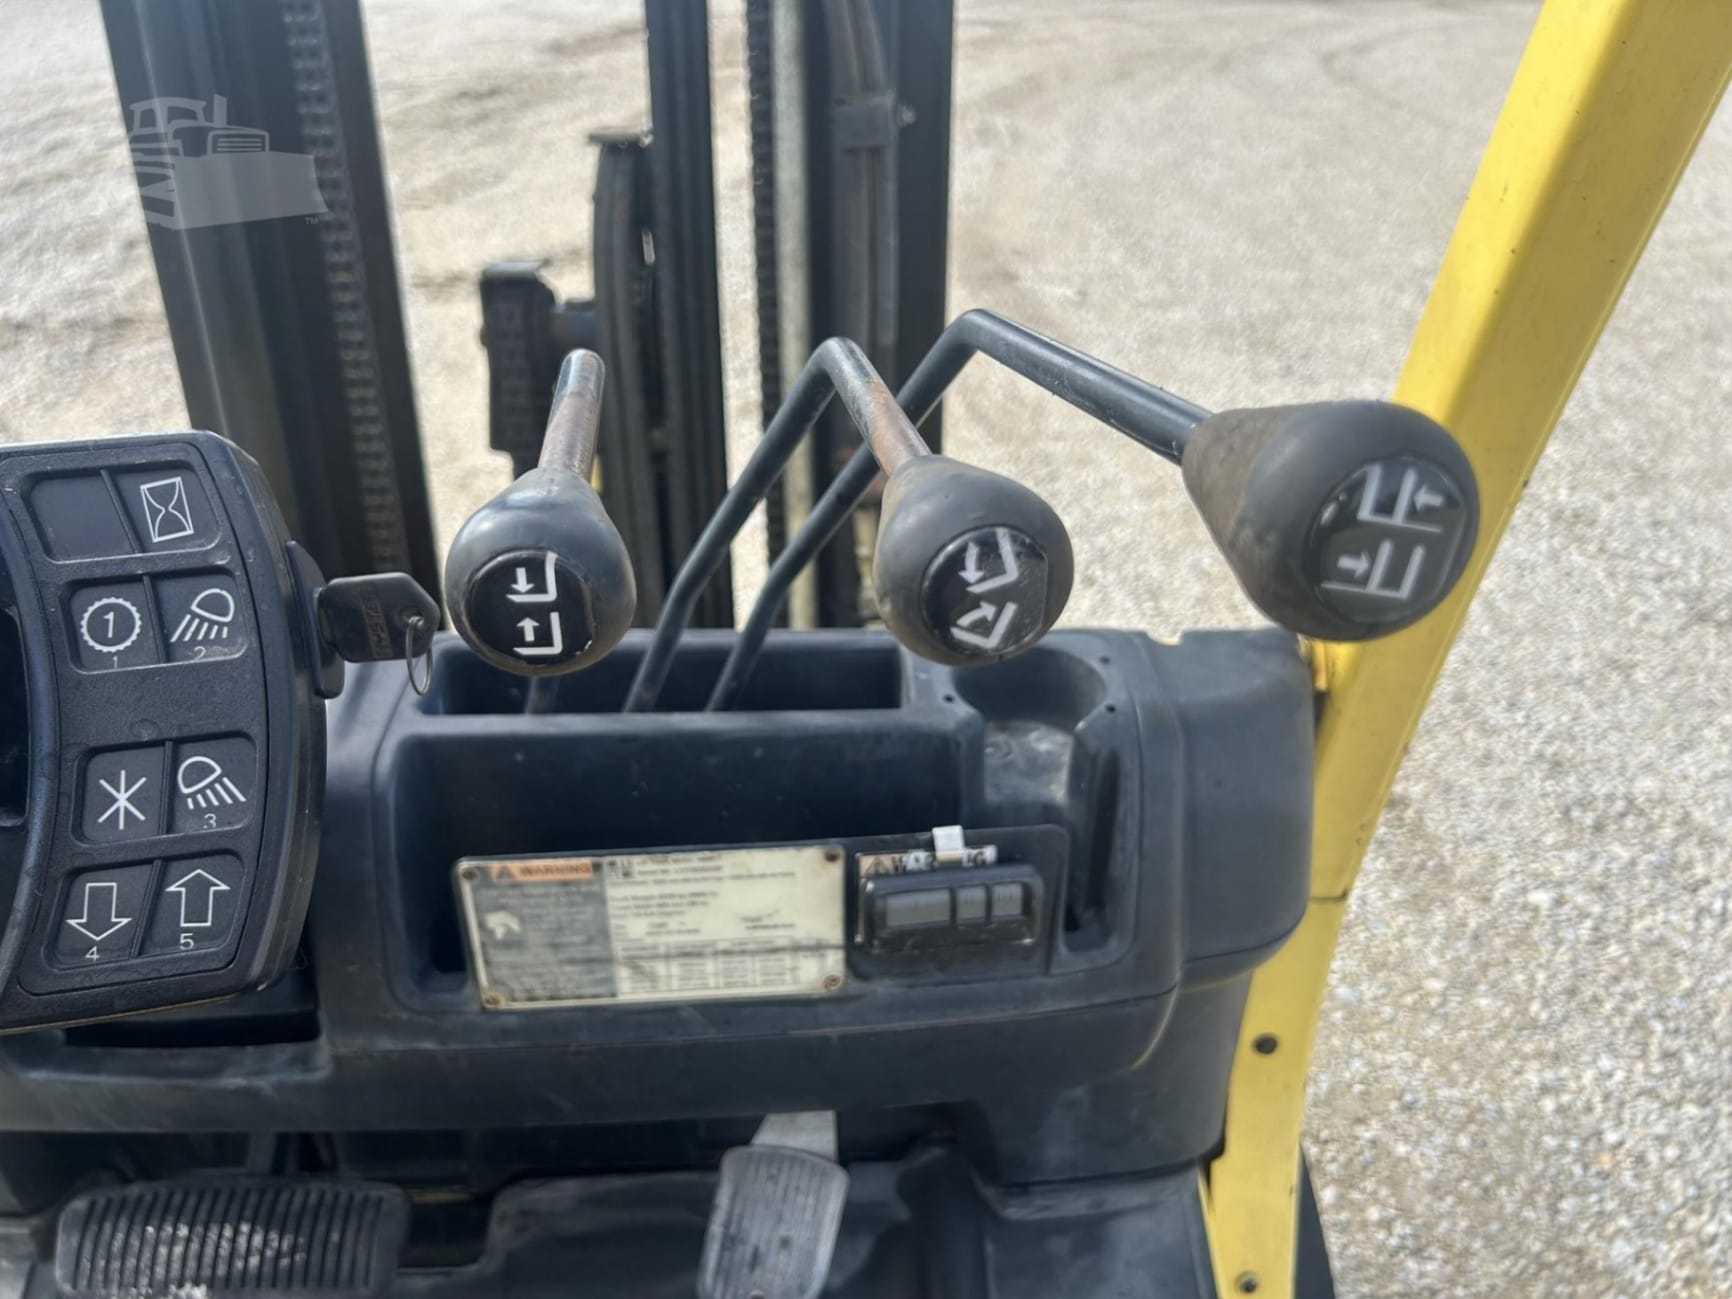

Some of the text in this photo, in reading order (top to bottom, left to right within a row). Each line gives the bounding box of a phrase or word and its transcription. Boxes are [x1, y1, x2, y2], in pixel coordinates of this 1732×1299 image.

[103, 611, 115, 639] 1
[112, 655, 118, 669] 1
[192, 646, 206, 662] 2
[203, 813, 217, 829] 3
[519, 862, 591, 877] WARNING
[179, 933, 194, 950] 5
[85, 946, 100, 962] 4
